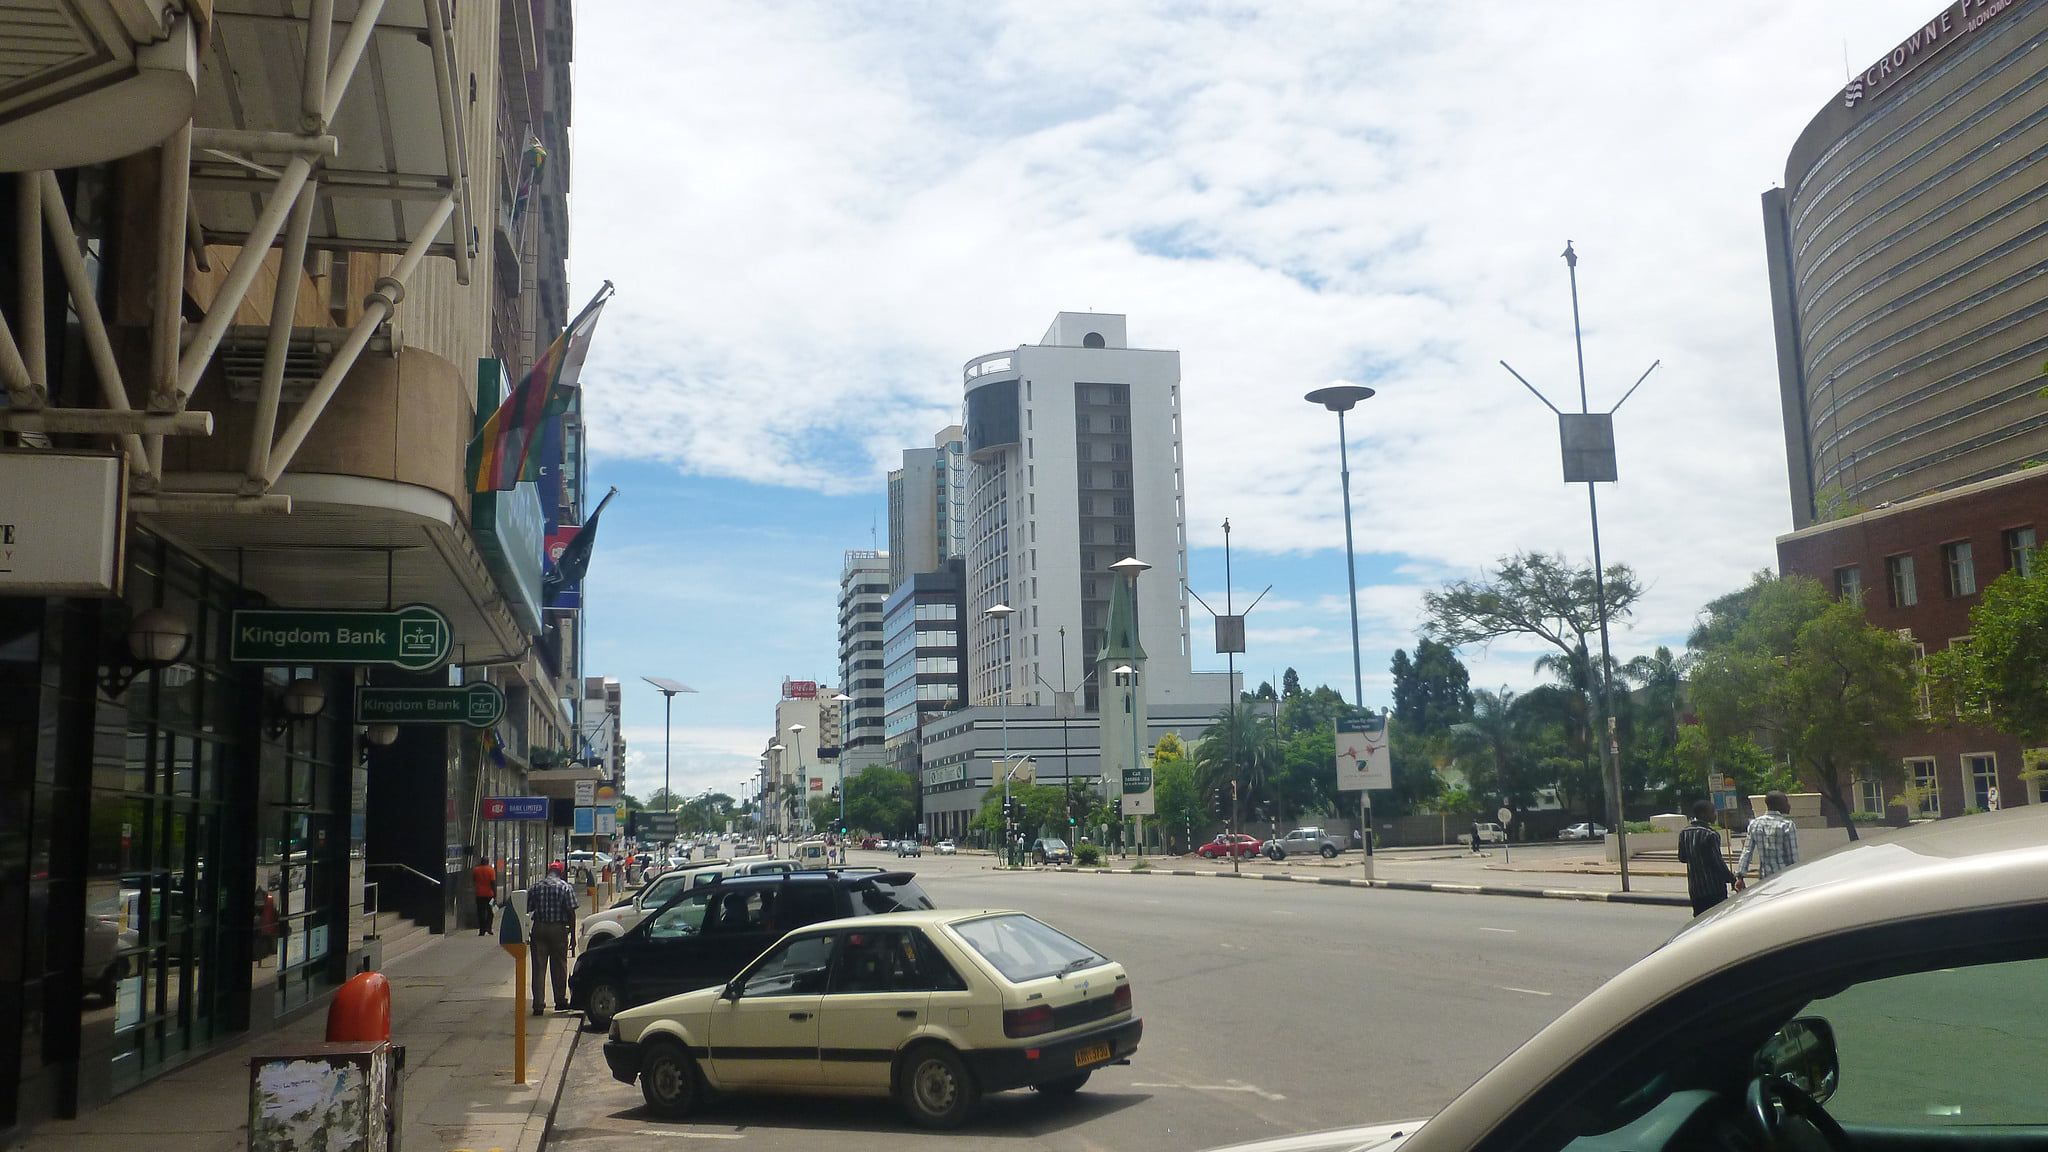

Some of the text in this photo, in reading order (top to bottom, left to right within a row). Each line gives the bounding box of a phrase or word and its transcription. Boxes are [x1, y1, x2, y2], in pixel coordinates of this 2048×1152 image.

[1866, 10, 1951, 86] CROWNE
[241, 626, 387, 647] Kingdom Bank
[364, 699, 461, 712] Kingdom Bank
